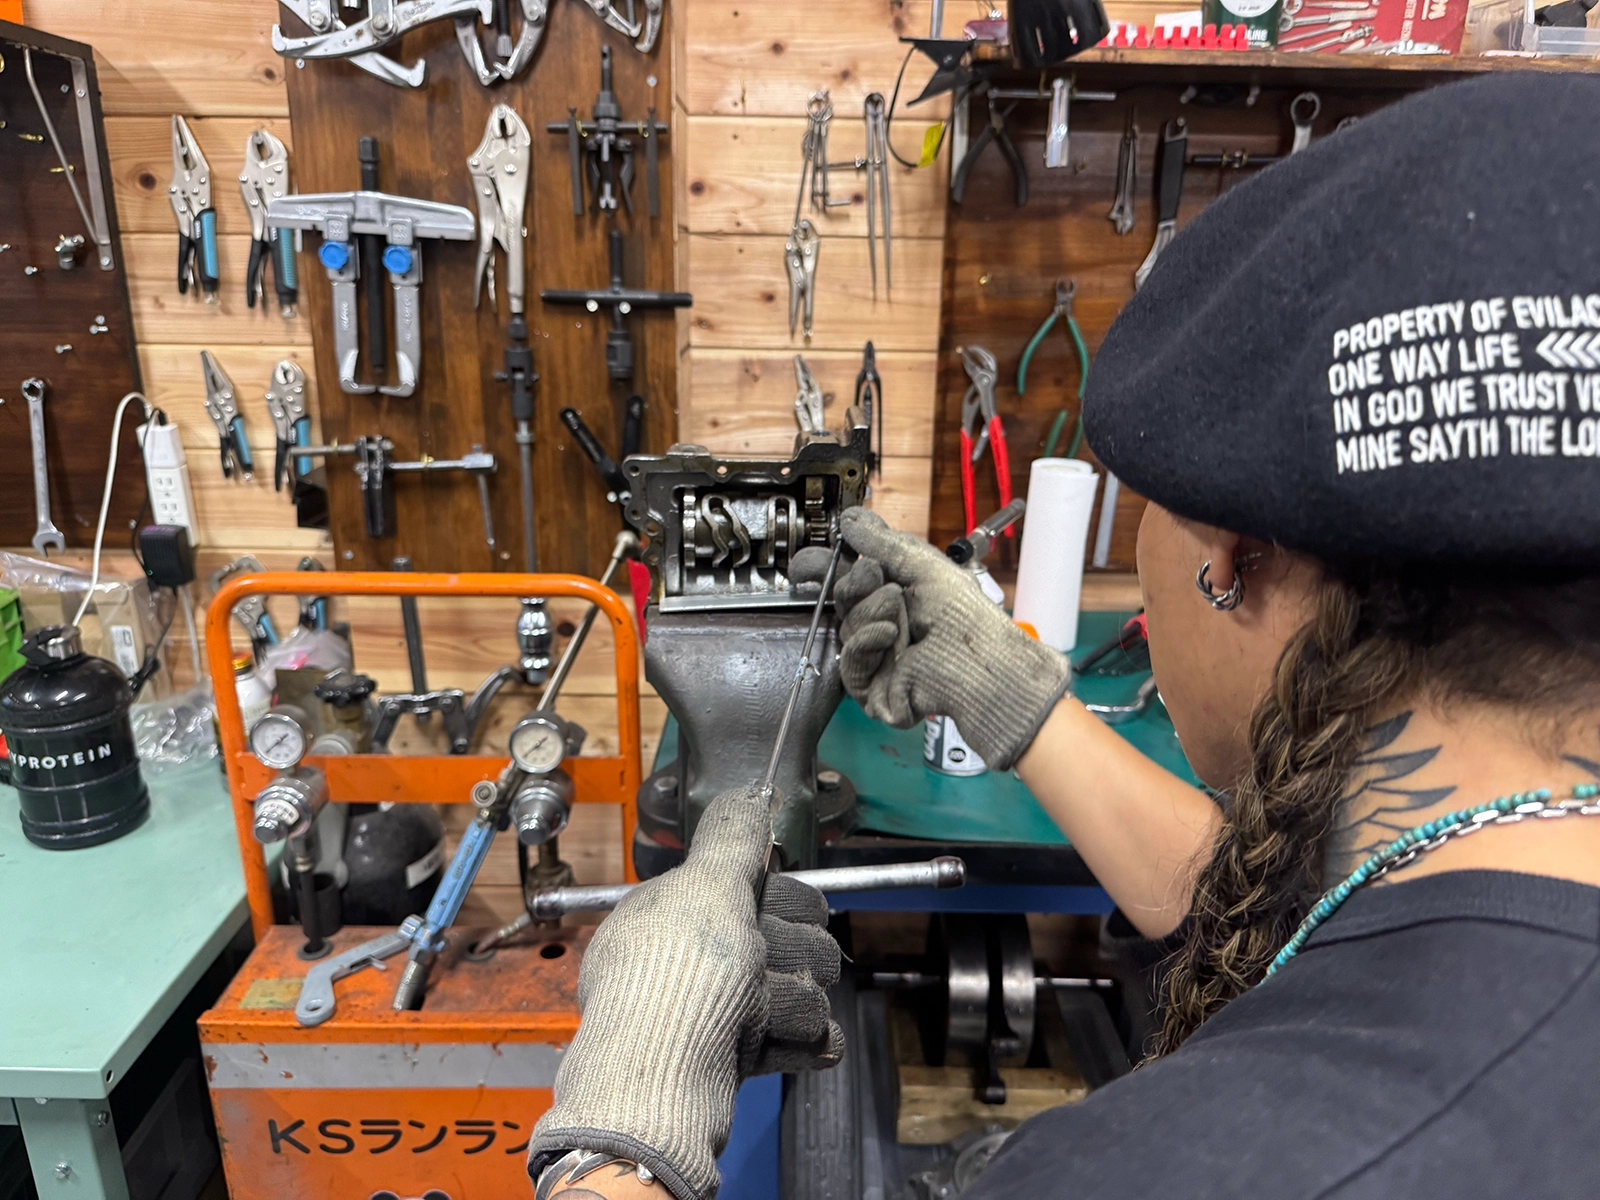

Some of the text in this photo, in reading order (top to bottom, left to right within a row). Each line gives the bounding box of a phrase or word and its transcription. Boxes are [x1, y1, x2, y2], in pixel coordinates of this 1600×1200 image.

[1333, 300, 1466, 360] PROPERTY
[1470, 297, 1508, 333] OF
[1328, 332, 1522, 396] ONE WAY LIFE
[1333, 395, 1362, 435] IN
[1368, 384, 1424, 428] GOD
[1430, 376, 1478, 419] WE
[1481, 371, 1570, 412] TRUST
[1336, 429, 1403, 475] MINE
[1409, 416, 1500, 464] SAYTH
[1504, 415, 1557, 458] THE
[9, 743, 112, 770] YPROTEIN
[267, 1118, 530, 1155] KSランラン
